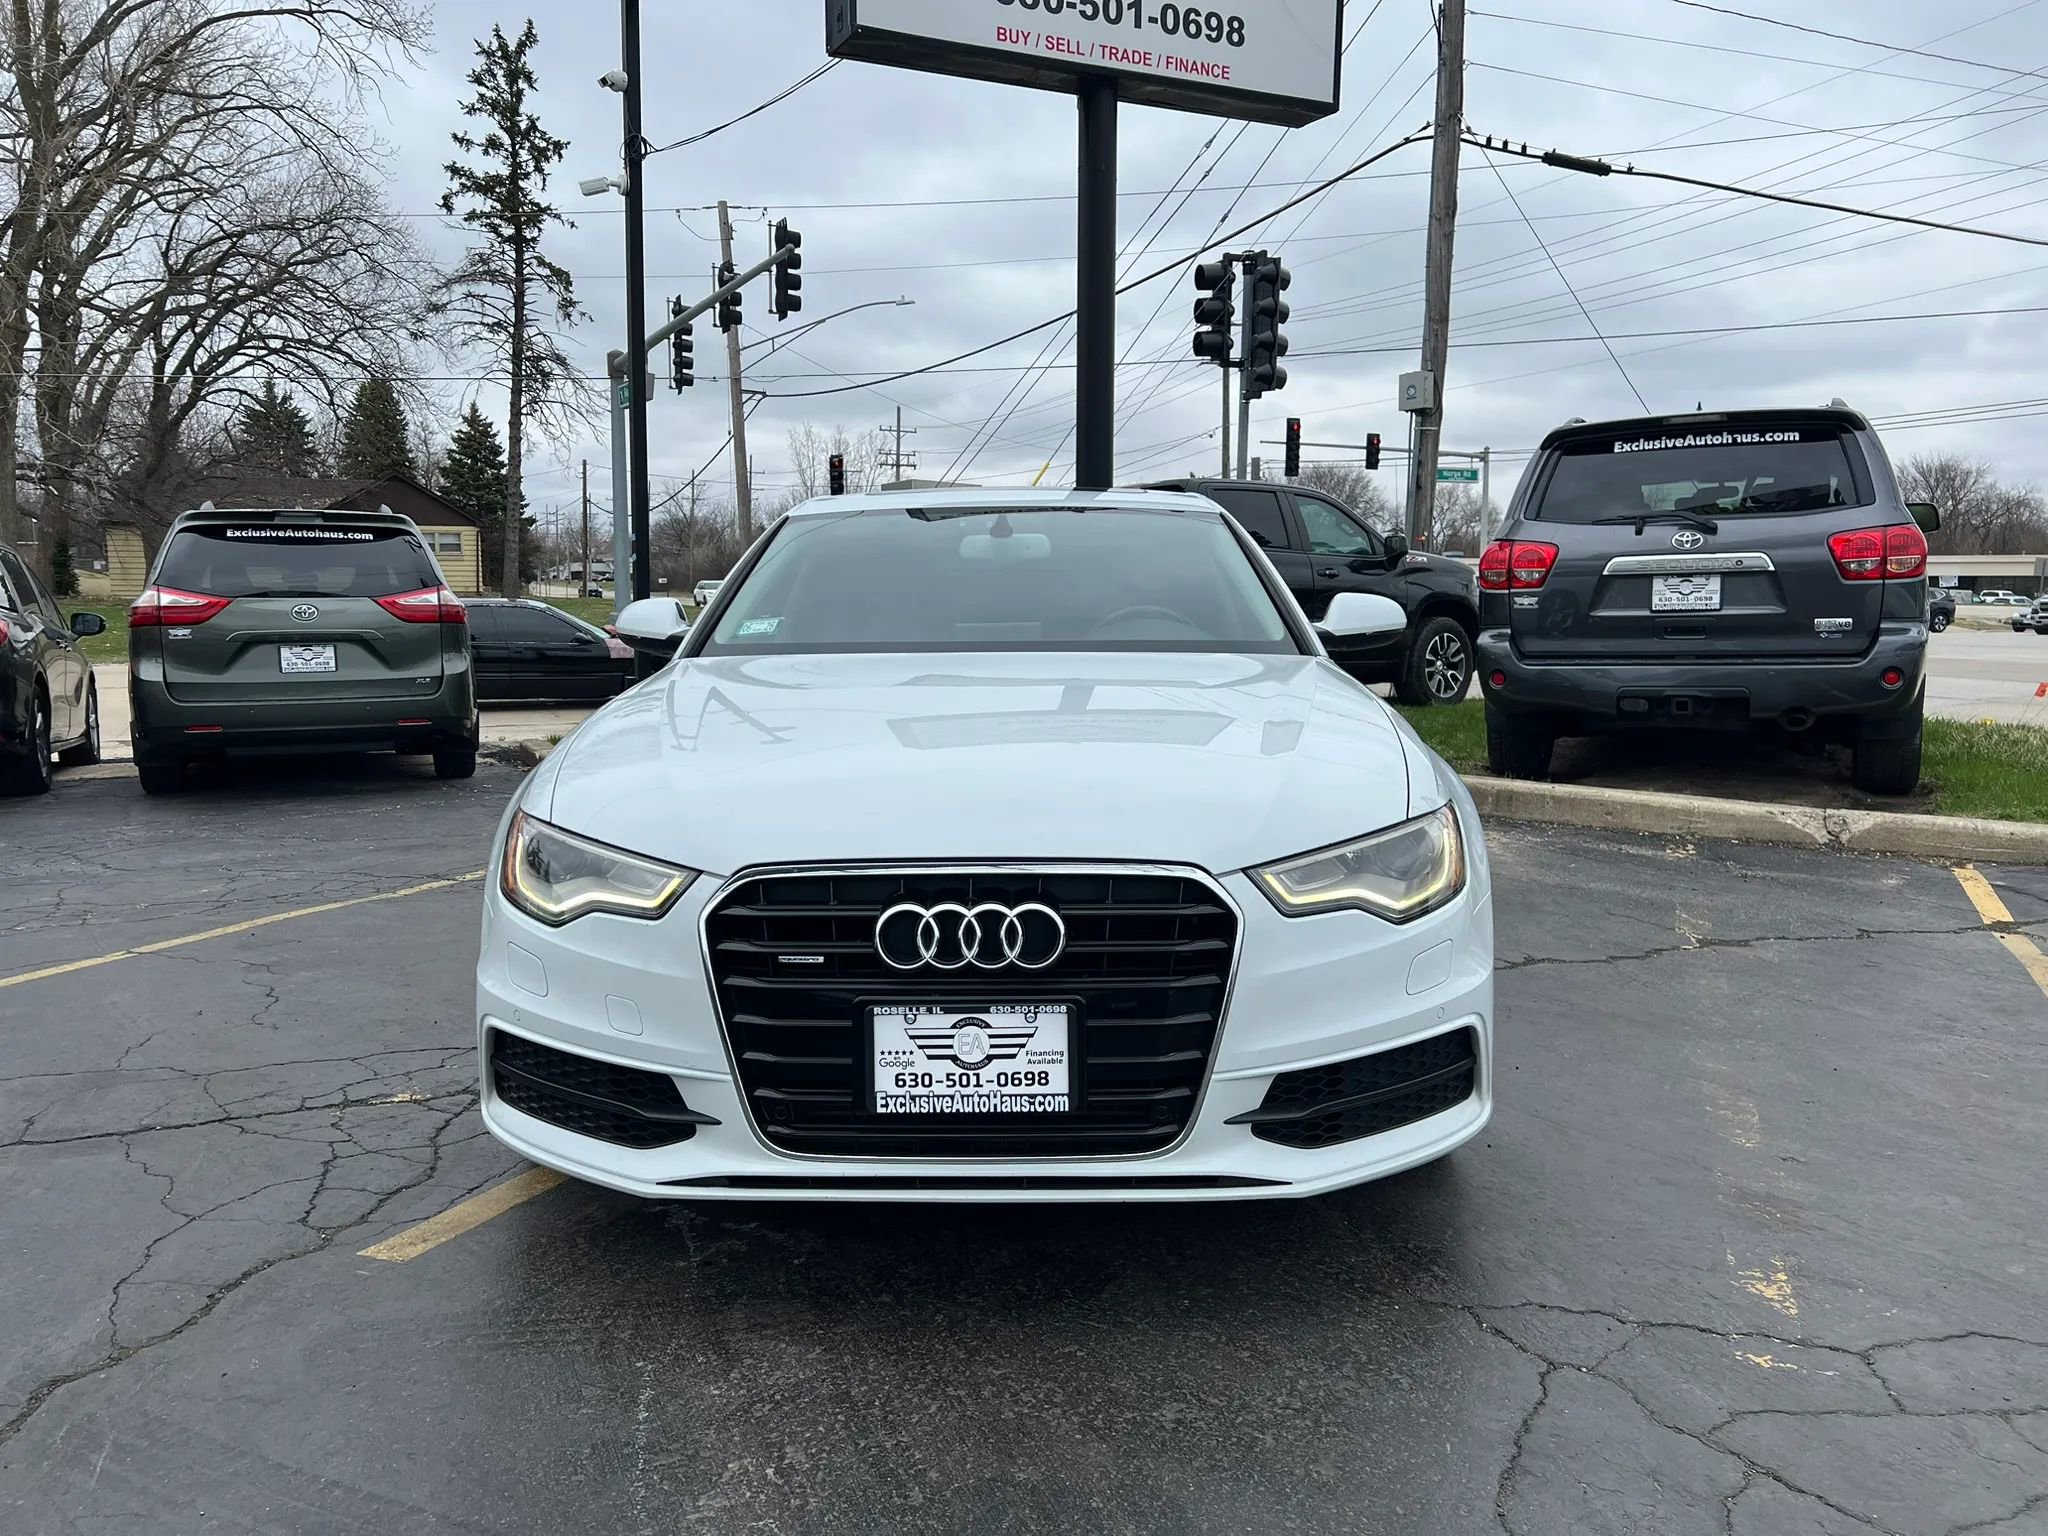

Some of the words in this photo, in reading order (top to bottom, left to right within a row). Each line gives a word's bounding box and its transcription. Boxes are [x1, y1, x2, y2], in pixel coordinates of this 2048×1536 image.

[996, 0, 1245, 47] -501-0698
[996, 26, 1031, 46] BUY
[1035, 33, 1041, 48] /
[1044, 35, 1086, 56] SELL
[1089, 42, 1095, 57] /
[1099, 44, 1152, 67] TRADE
[1156, 53, 1162, 68] /
[1165, 55, 1231, 80] FINANCE
[226, 528, 374, 541] ExclusiveAutohaus.com
[1636, 559, 1734, 571] SEQUOIA
[873, 1007, 931, 1015] ROSELLE,
[955, 1018, 986, 1028] EXCLUSIVE
[958, 1033, 986, 1055] EA
[879, 1057, 915, 1070] Google
[955, 1060, 989, 1069] AUTOHAUS
[1027, 1057, 1064, 1065] Available
[894, 1071, 1050, 1088] 630-501-0698
[876, 1091, 1070, 1113] ExclusiveAutoHaus.com
